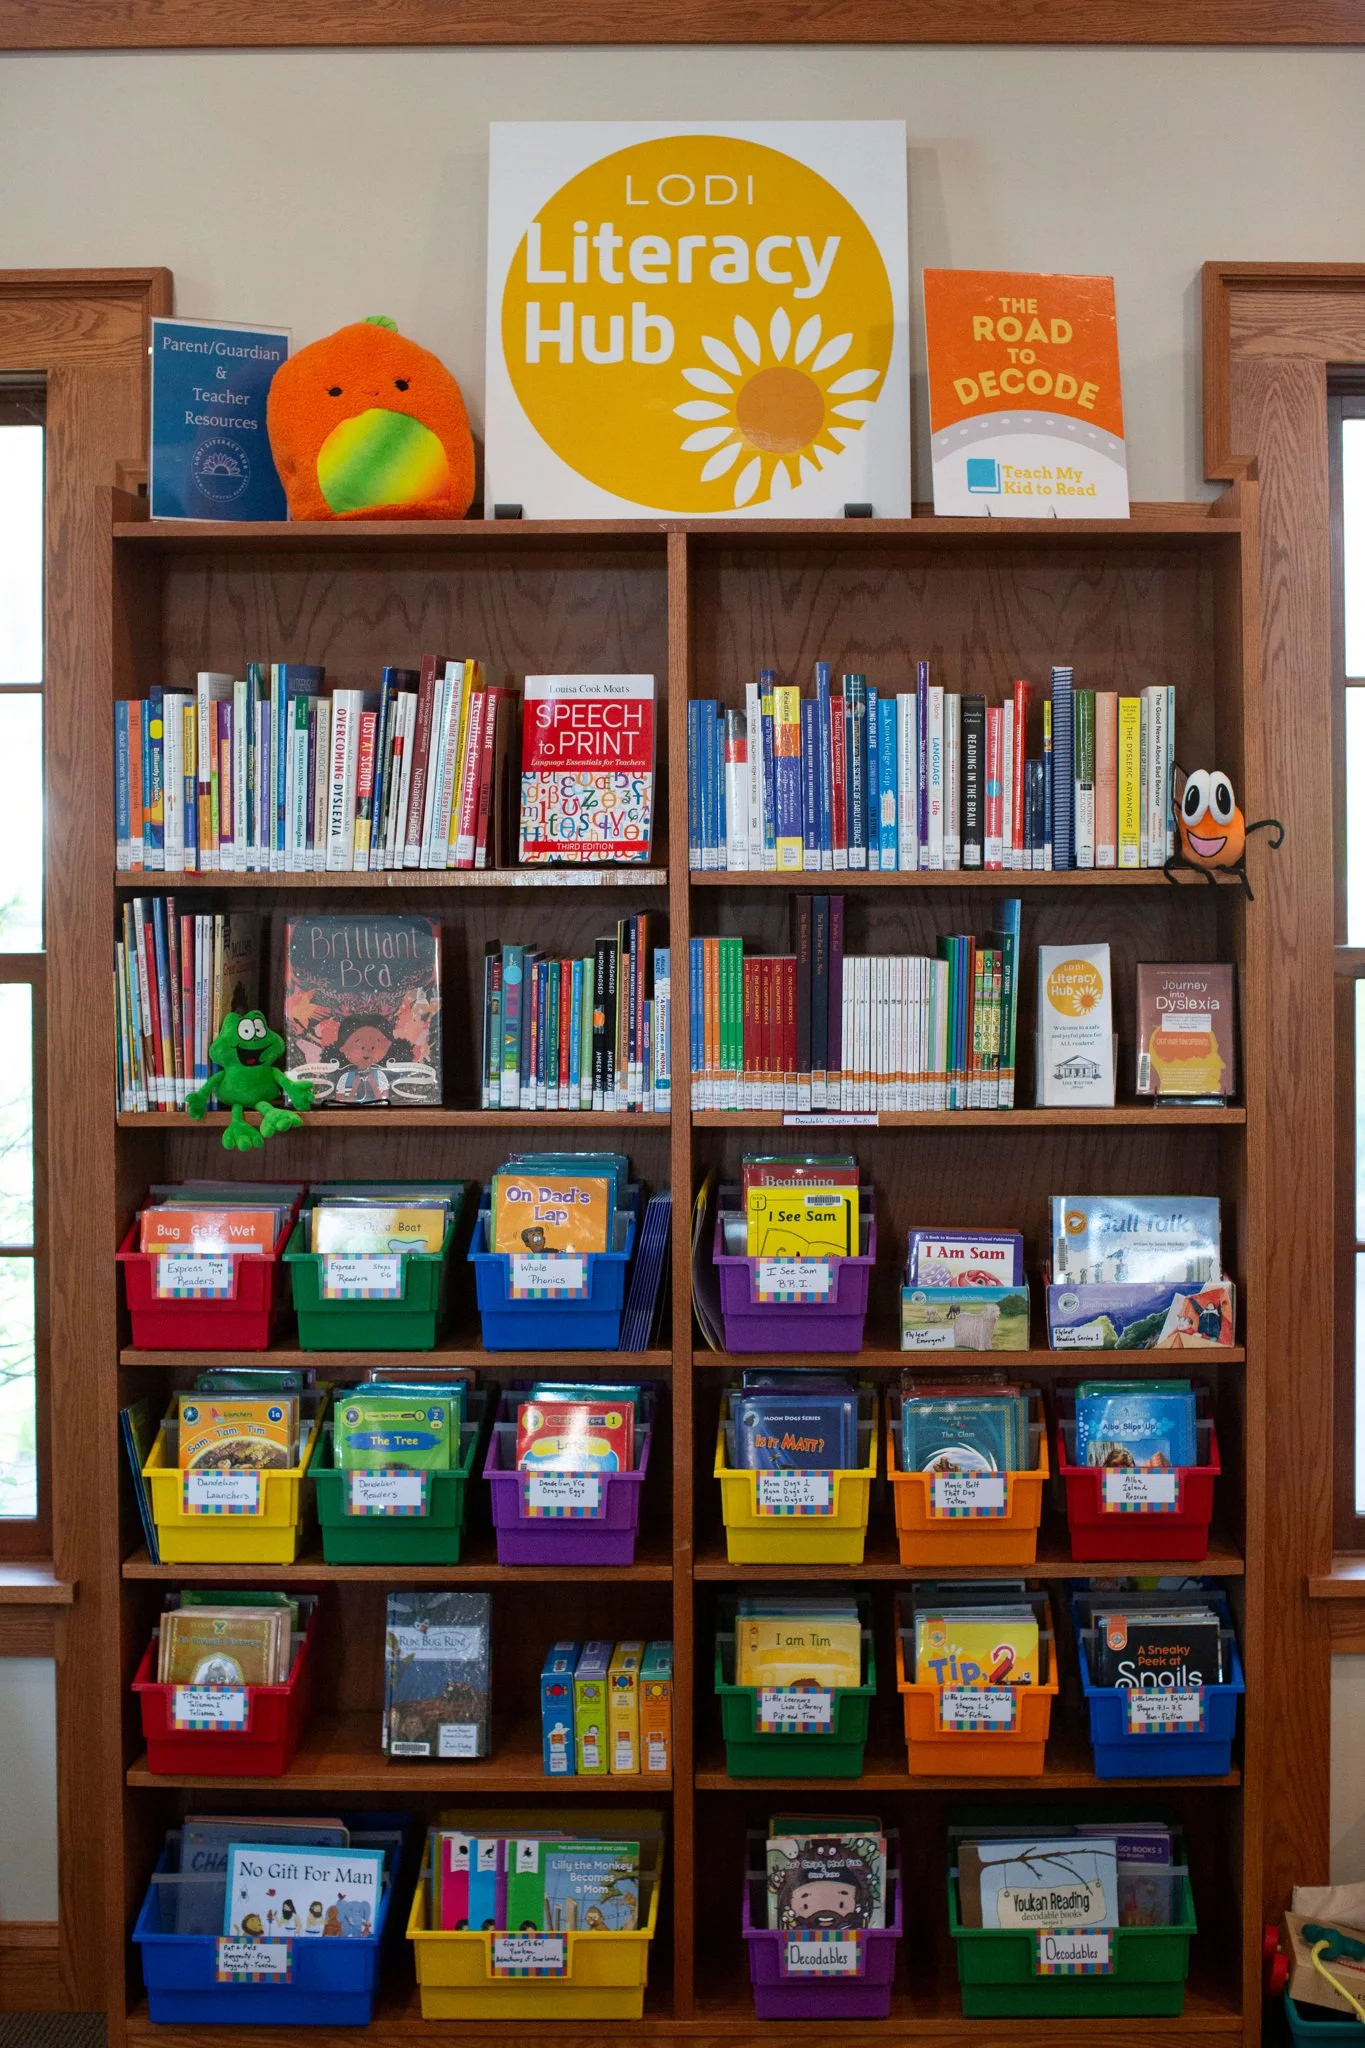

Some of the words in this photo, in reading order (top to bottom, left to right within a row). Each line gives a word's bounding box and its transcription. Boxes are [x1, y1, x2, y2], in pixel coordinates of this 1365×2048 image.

[625, 174, 753, 206] LODI
[526, 220, 841, 299] Literacy
[999, 297, 1038, 314] THE
[525, 301, 675, 364] Hub
[973, 316, 1072, 344] ROAD
[163, 336, 280, 361] Parent/Guardian
[1007, 348, 1036, 365] TO
[216, 366, 227, 379] &
[192, 388, 249, 405] Teacher
[953, 368, 1099, 409] DECODE
[185, 411, 258, 429] Resources
[1002, 465, 1051, 479] Teach
[1056, 467, 1082, 483] My
[1003, 482, 1033, 494] Kid
[1036, 484, 1051, 494] to
[1056, 484, 1096, 496] Read
[452, 679, 460, 699] Teach
[579, 685, 601, 693] Cook
[604, 684, 629, 693] Moats
[486, 695, 495, 721] READING
[536, 704, 642, 728] SPEECH
[362, 716, 373, 738] LOST
[449, 719, 458, 738] Child
[486, 723, 494, 734] FOR
[834, 711, 842, 740] Reading
[334, 708, 347, 779] OVERCOMING
[362, 742, 372, 754] AT
[485, 736, 493, 749] LIFE
[539, 741, 555, 754] to
[559, 731, 639, 755] PRINT
[446, 748, 455, 766] Read
[967, 734, 976, 769] READING
[152, 748, 160, 776] Brilliantly
[531, 759, 564, 767] Language
[603, 759, 614, 767] for
[615, 758, 645, 766] Teachers
[932, 737, 940, 785] LANGUAGE
[360, 756, 372, 792] SCHOOL
[967, 773, 976, 781] IN
[445, 778, 453, 790] 100
[967, 784, 976, 798] THE
[442, 792, 451, 809] Easy
[332, 784, 343, 836] DYSLEXIA
[967, 802, 976, 827] BRAIN
[440, 811, 449, 840] Lessons
[311, 926, 420, 959] Brilliant
[340, 959, 392, 987] Bea
[1051, 973, 1096, 984] Literacy
[1051, 985, 1073, 996] Hub
[1162, 980, 1207, 991] Journey
[1156, 996, 1220, 1012] Dyslexia
[506, 1186, 532, 1202] On
[538, 1186, 590, 1204] Dad's
[534, 1206, 568, 1225] Lap
[769, 1212, 772, 1222] I
[778, 1211, 800, 1222] See
[806, 1211, 837, 1222] Sam
[157, 1225, 180, 1238] Bug
[191, 1224, 220, 1237] Gets
[229, 1225, 256, 1237] Wet
[926, 1246, 932, 1258] I
[937, 1246, 964, 1258] Am
[970, 1247, 1005, 1260] Sam
[168, 1263, 203, 1274] Express
[331, 1263, 356, 1271] Express
[521, 1264, 547, 1272] Whole
[766, 1268, 776, 1276] I
[780, 1267, 797, 1275] See
[800, 1266, 817, 1274] Sam
[528, 1275, 565, 1284] Phonics
[611, 1416, 616, 1424] 1
[1123, 1423, 1141, 1432] Slips
[1145, 1423, 1156, 1432] Up
[187, 1438, 211, 1455] Sam,
[214, 1426, 240, 1437] Tam,
[247, 1425, 265, 1435] Tim
[370, 1436, 390, 1445] The
[394, 1436, 419, 1445] Tree
[754, 1435, 766, 1448] IS
[768, 1436, 779, 1447] IT
[782, 1432, 824, 1453] MATT?
[944, 1481, 962, 1489] Magic
[963, 1489, 976, 1498] Dog
[360, 1490, 398, 1499] Readers
[776, 1633, 780, 1646] I
[786, 1637, 805, 1646] am
[810, 1634, 831, 1646] Tim
[1138, 1646, 1145, 1655] A
[1148, 1645, 1191, 1656] Sneaky
[1138, 1656, 1165, 1666] Peek
[1169, 1656, 1182, 1666] at
[1115, 1661, 1203, 1688] Snails
[773, 1712, 784, 1720] Pip
[239, 1862, 263, 1877] No
[268, 1863, 299, 1880] Gift
[304, 1866, 330, 1881] For
[335, 1868, 374, 1885] Man
[552, 1860, 572, 1872] Lilly
[575, 1860, 591, 1870] the
[593, 1860, 633, 1873] Monkey
[570, 1873, 614, 1882] Becomes
[583, 1884, 609, 1894] Mom
[1014, 1894, 1049, 1913] Youkan
[1050, 1892, 1090, 1912] Reading
[1022, 1911, 1058, 1921] decodable
[1060, 1911, 1082, 1919] books
[790, 1944, 848, 1965] Decodables
[1045, 1937, 1099, 1961] Decodables
